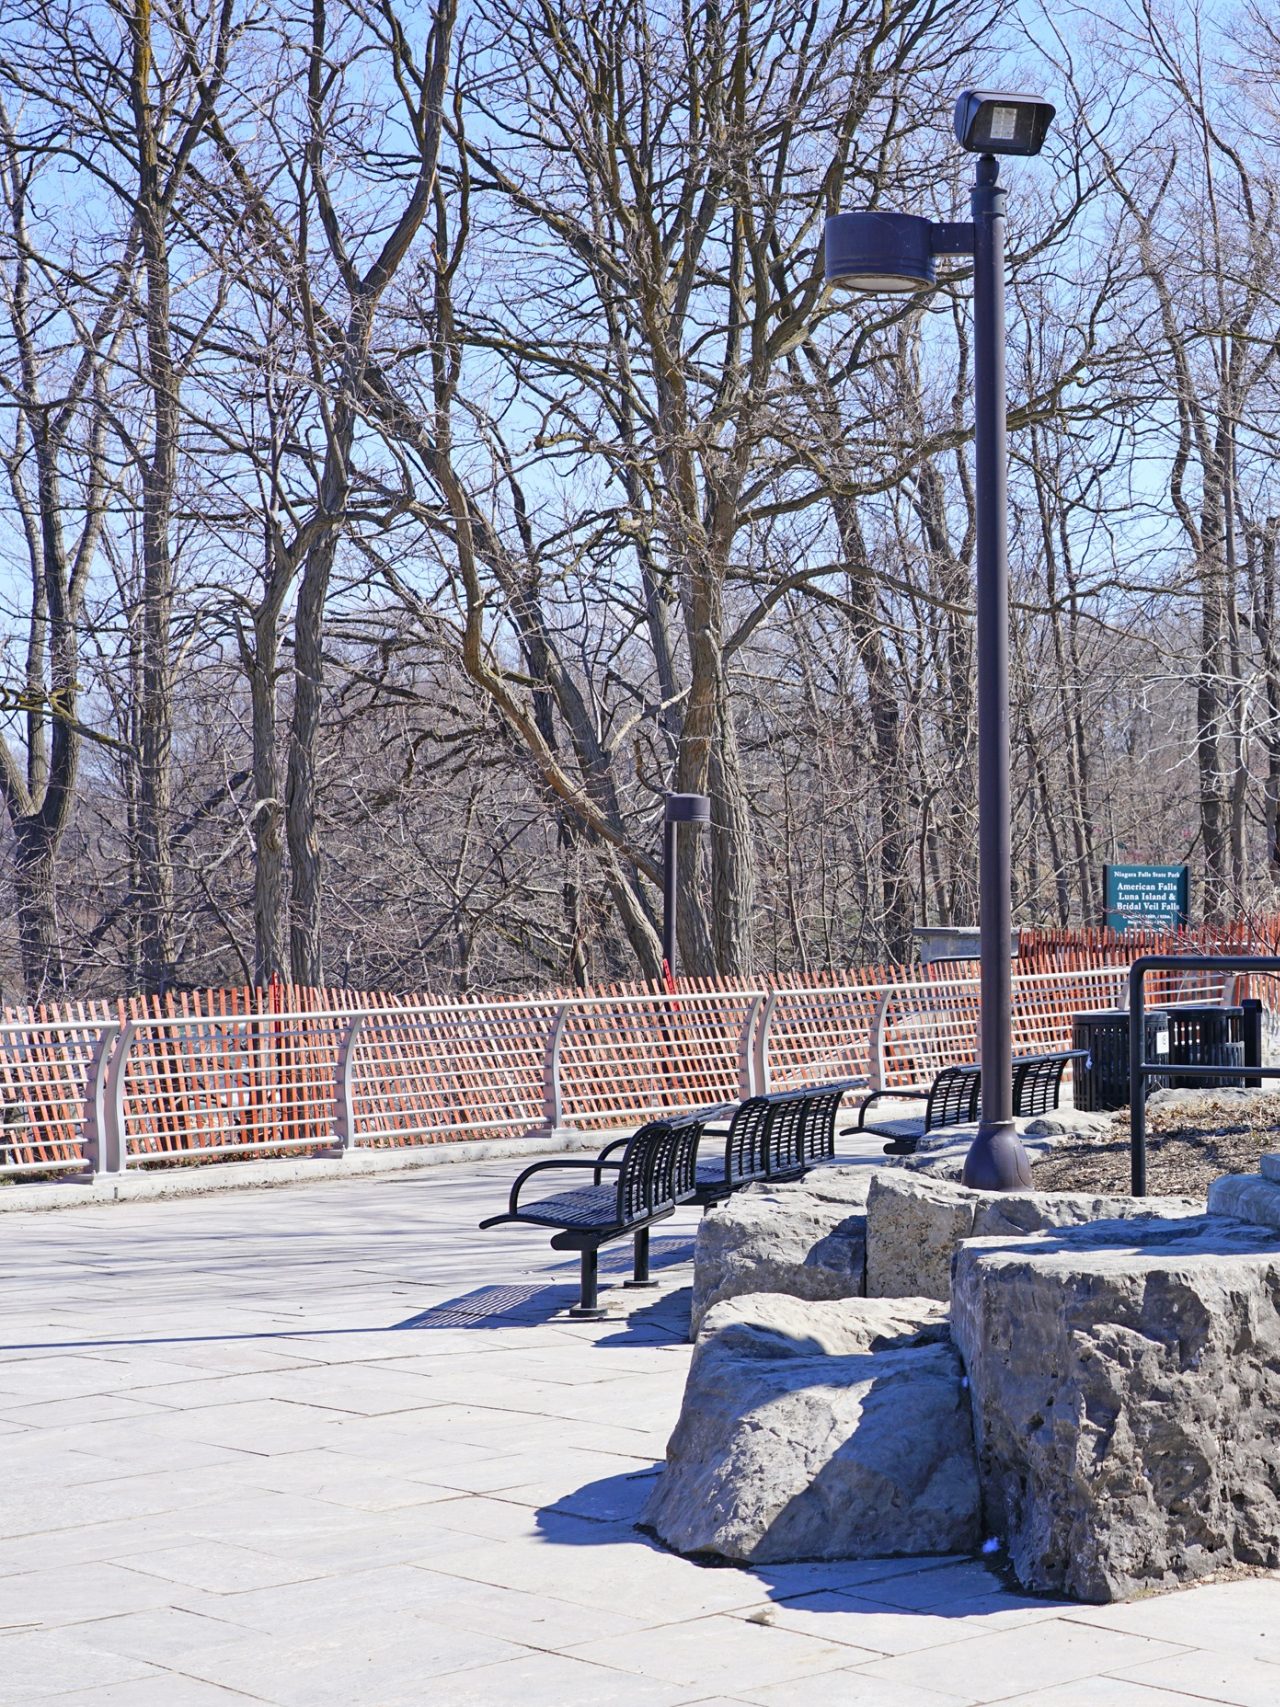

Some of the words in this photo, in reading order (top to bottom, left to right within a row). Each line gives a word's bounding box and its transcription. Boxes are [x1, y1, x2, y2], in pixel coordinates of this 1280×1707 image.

[1114, 871, 1136, 879] Niagara
[1117, 882, 1156, 890] American
[1158, 882, 1177, 890] Falls
[1118, 892, 1138, 900] Luna
[1142, 892, 1166, 900] Island
[1168, 892, 1176, 900] &
